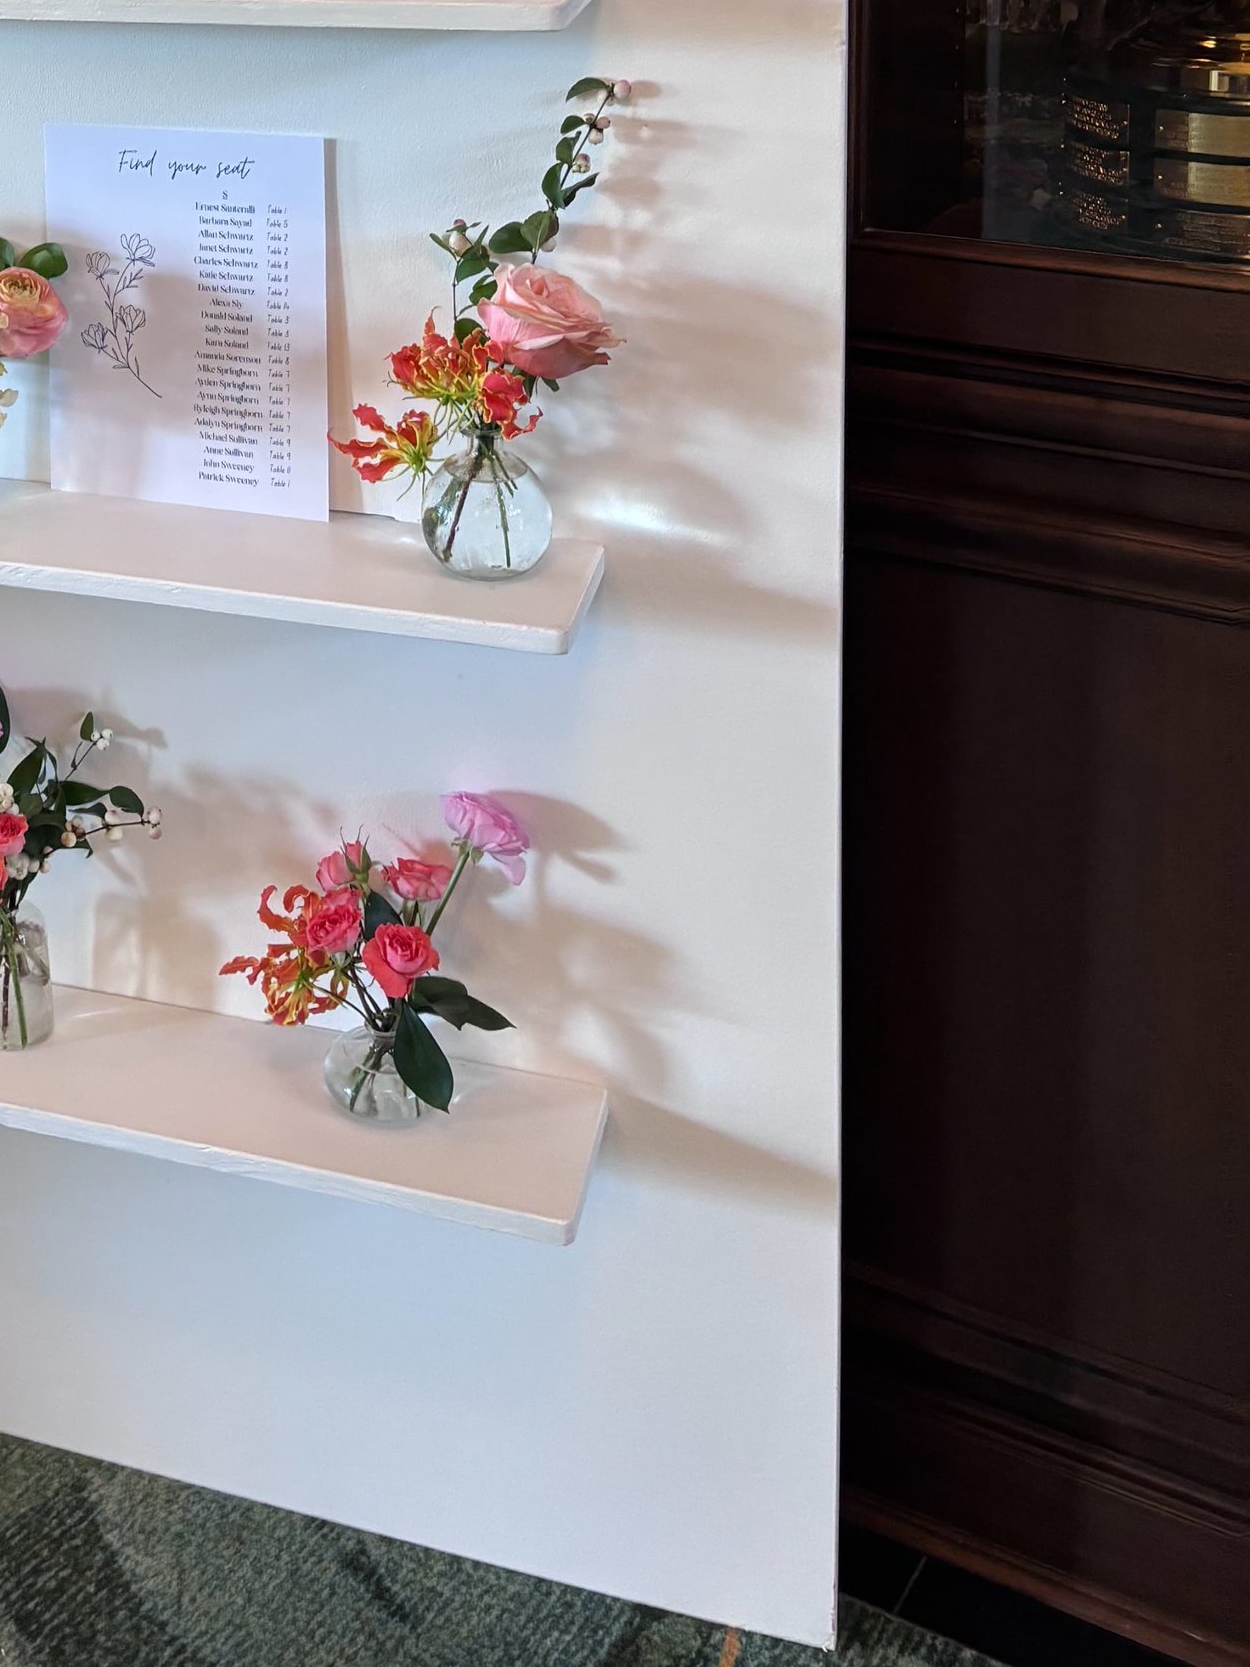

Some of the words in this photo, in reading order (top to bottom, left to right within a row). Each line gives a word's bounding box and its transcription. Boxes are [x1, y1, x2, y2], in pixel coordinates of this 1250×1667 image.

[118, 149, 158, 176] Find
[168, 161, 207, 181] your
[215, 156, 255, 180] seat
[200, 243, 217, 252] Janet
[219, 244, 253, 255] Schwartz
[267, 245, 282, 255] Table
[199, 270, 217, 279] Katie
[219, 271, 253, 282] Schwartz
[268, 273, 282, 282] Table
[198, 283, 219, 292] David
[220, 285, 255, 295] Schwartz
[267, 286, 282, 296] Table
[194, 350, 224, 360] Amanda
[269, 355, 283, 364] Table
[197, 364, 216, 373] Mike
[269, 368, 283, 378] Table
[200, 431, 227, 442] Michael
[229, 435, 258, 445] Sullivan
[269, 437, 284, 446] Table
[203, 446, 223, 455] Anne
[224, 448, 253, 459] Sullivan
[269, 450, 284, 460] Table
